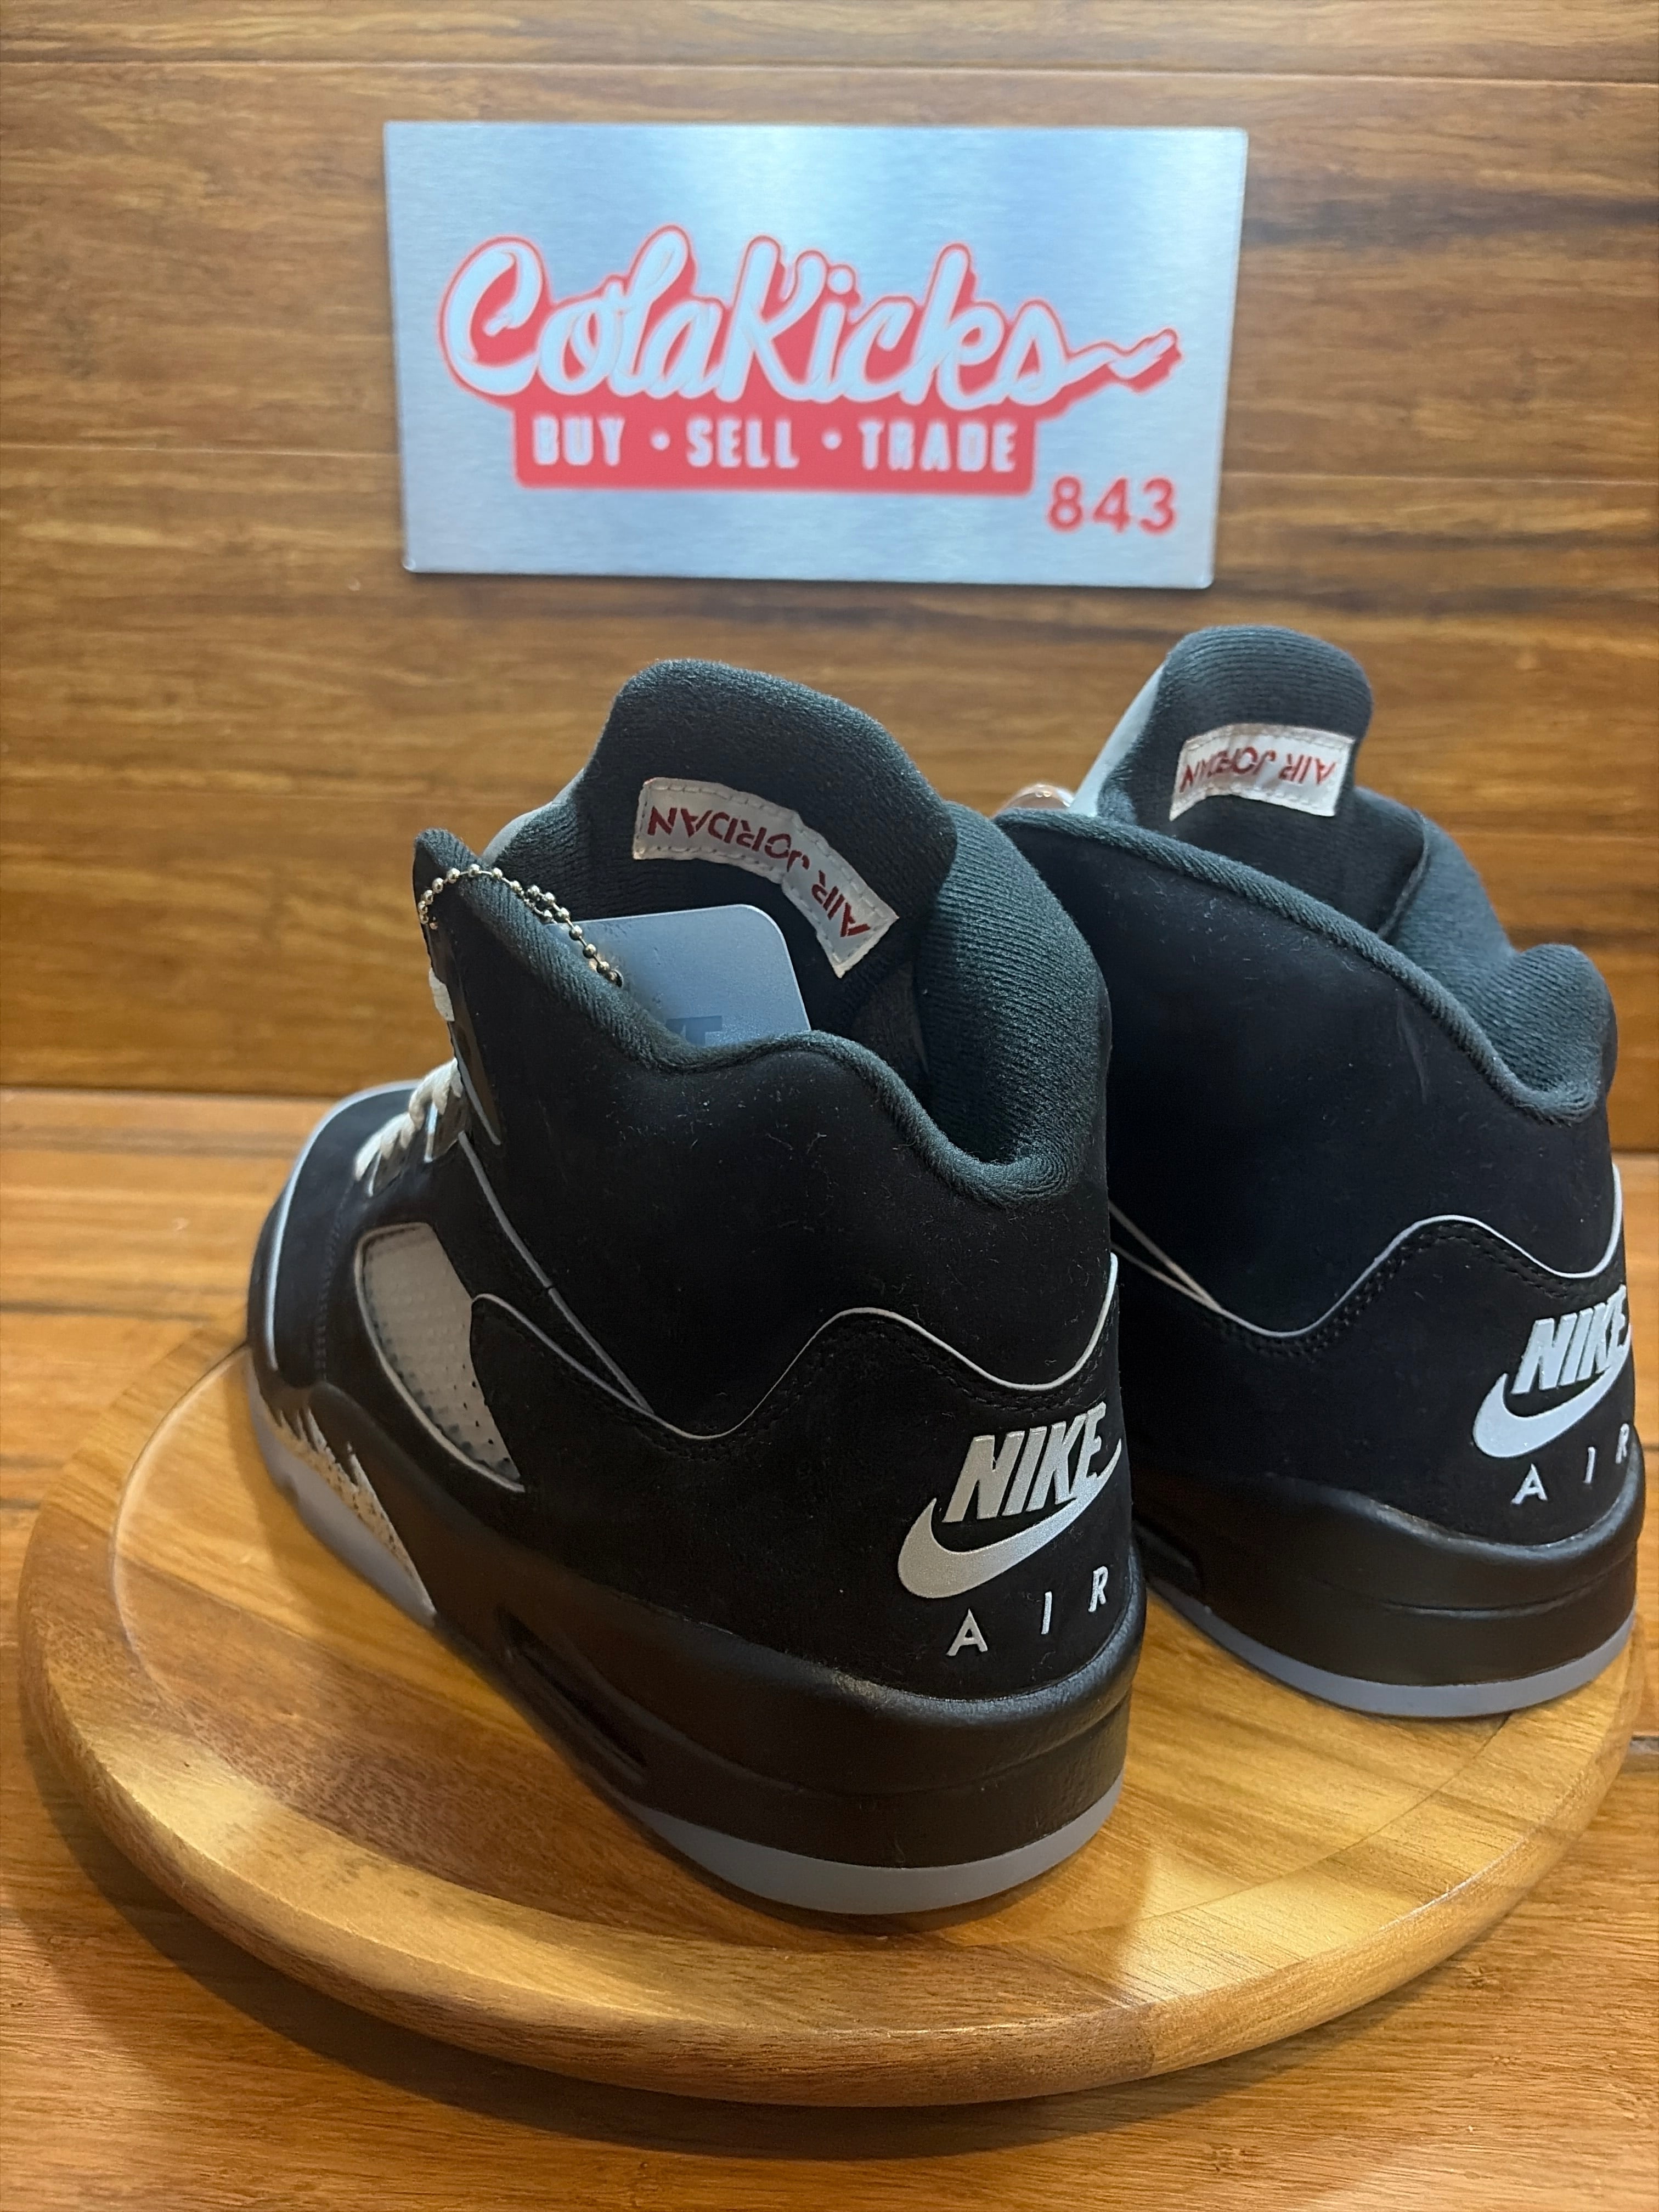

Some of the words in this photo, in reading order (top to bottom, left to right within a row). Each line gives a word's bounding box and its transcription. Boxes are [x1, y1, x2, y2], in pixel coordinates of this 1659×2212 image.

[441, 223, 1181, 410] ColaKicks
[532, 415, 625, 466] BUY
[686, 417, 799, 469] SELL
[857, 418, 1019, 473] TRADE
[1046, 476, 1176, 535] 843
[1278, 753, 1336, 786] AIR
[647, 806, 810, 873] JORDAN
[811, 870, 871, 938] AIR
[1510, 1283, 1627, 1395] NIKE
[941, 1401, 1107, 1524] NIKE
[1510, 1423, 1630, 1506] AIR
[945, 1565, 1109, 1657] AIR
